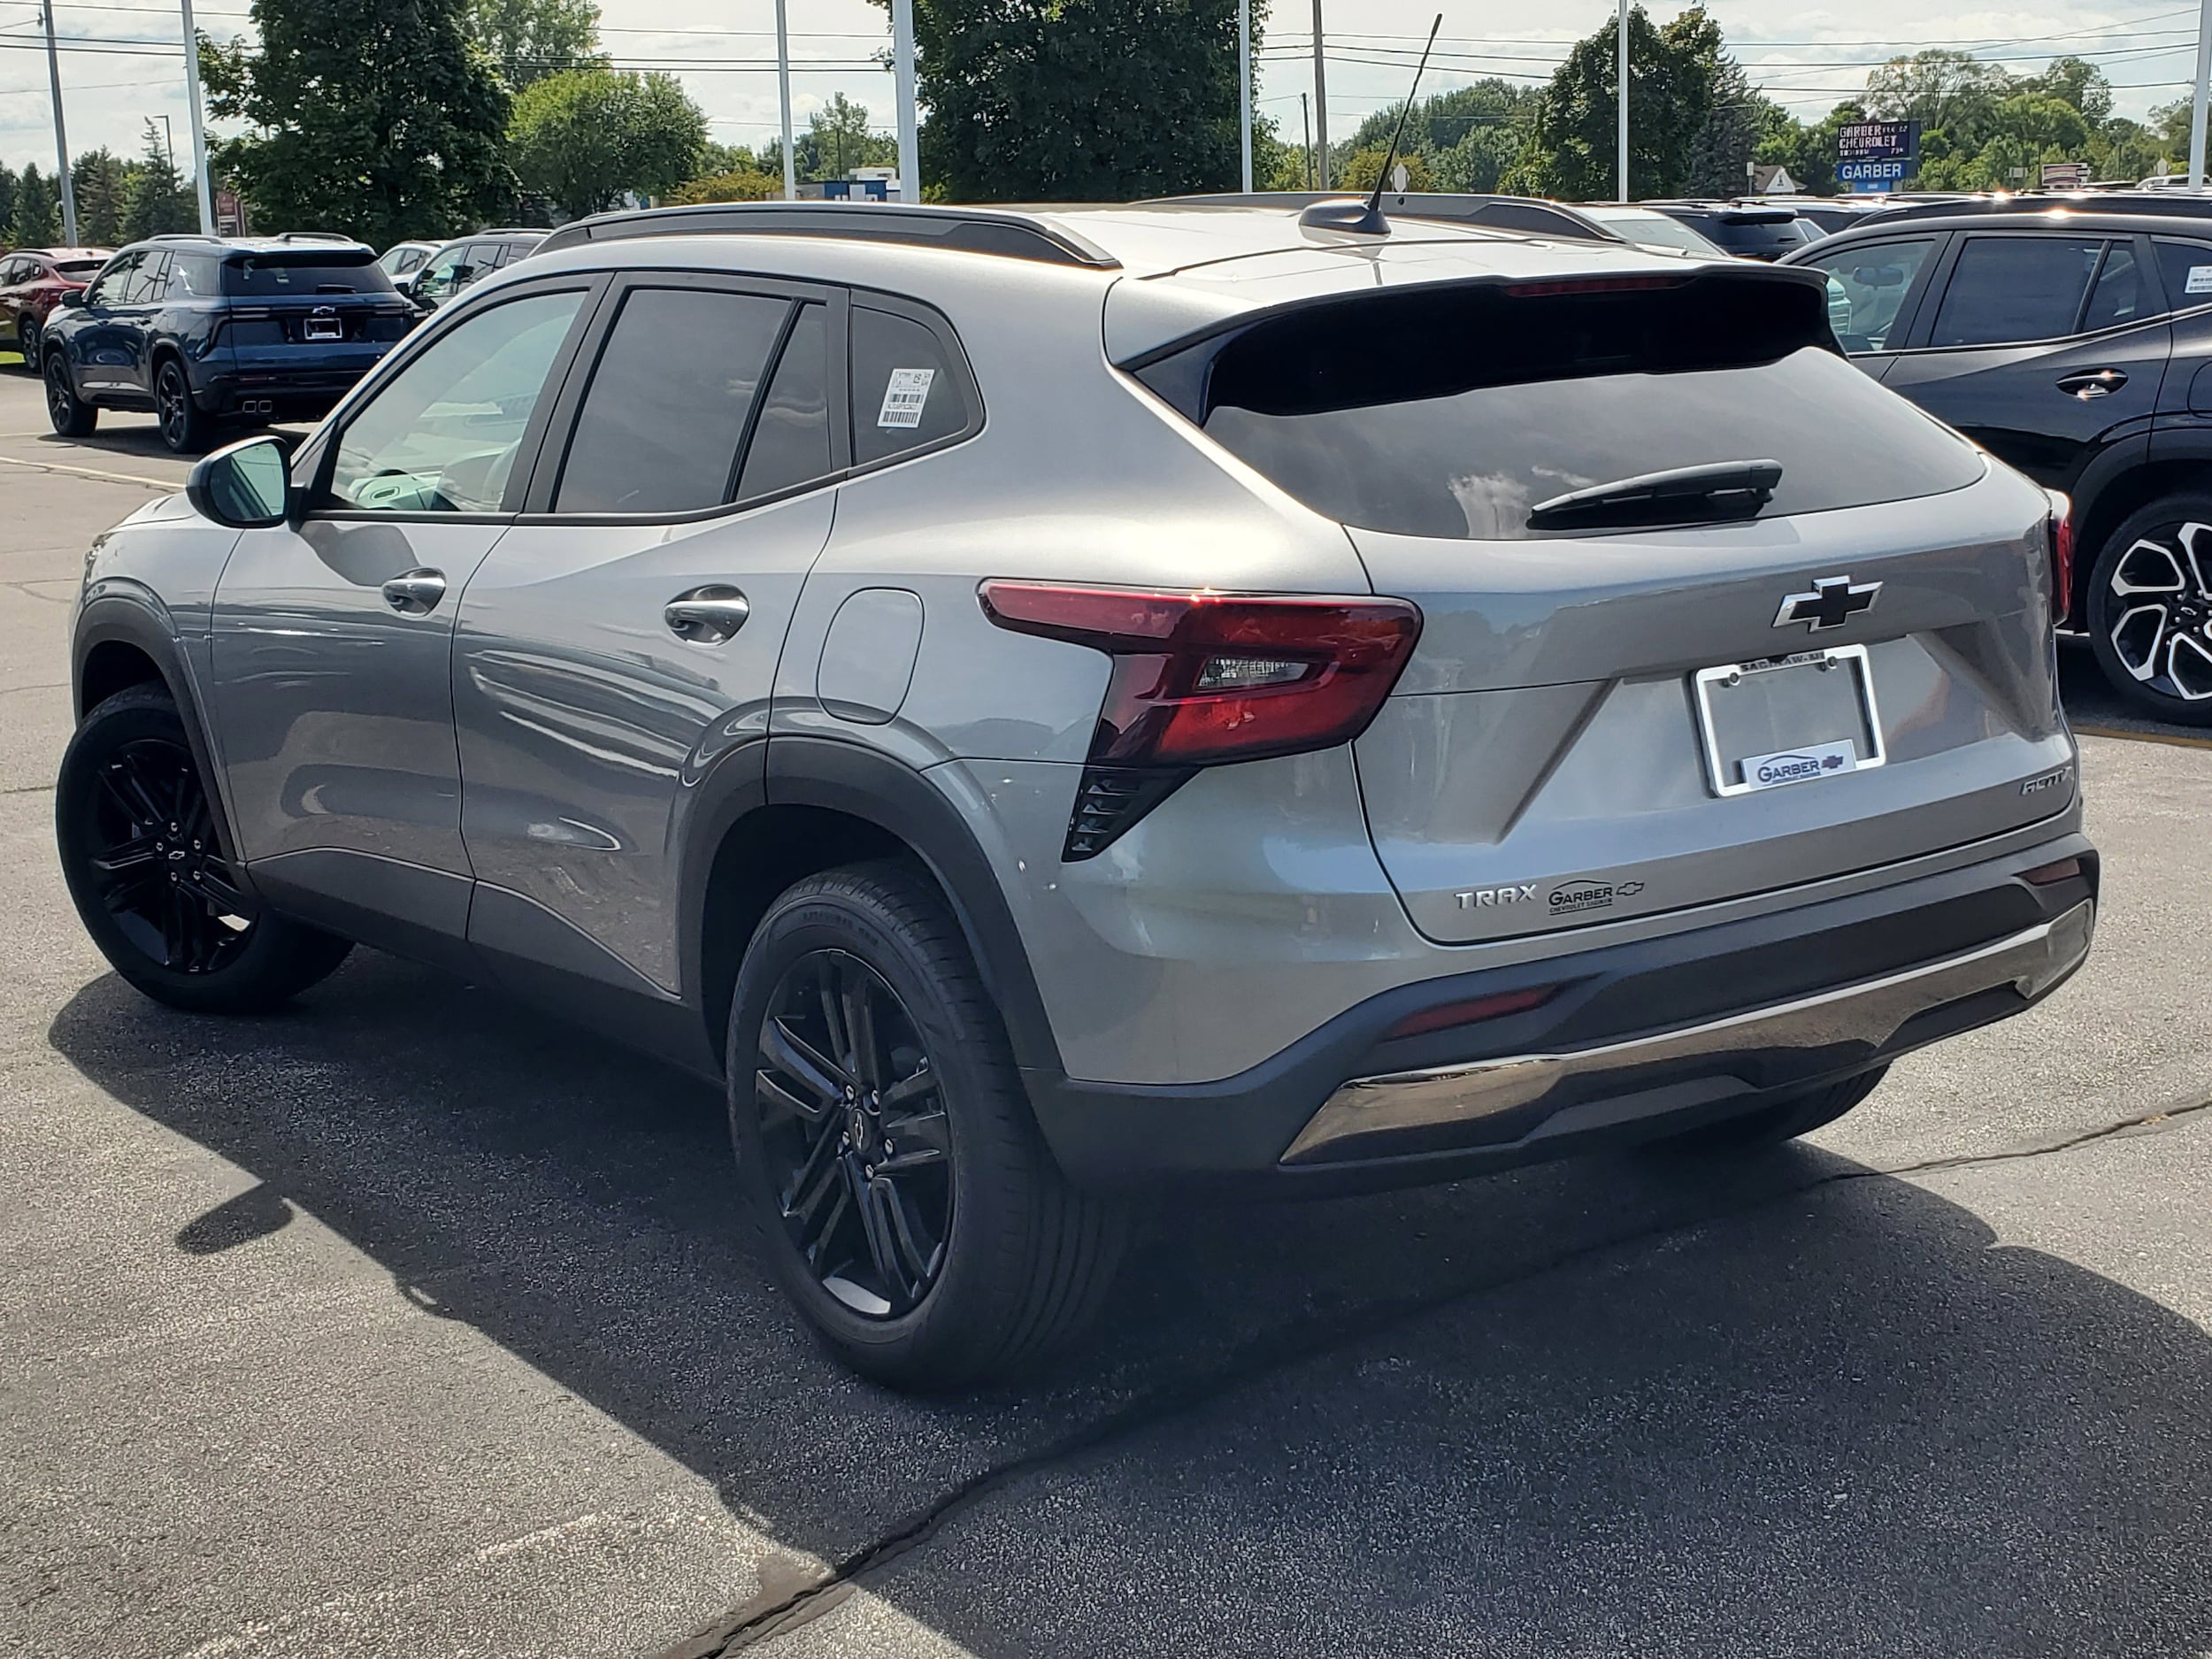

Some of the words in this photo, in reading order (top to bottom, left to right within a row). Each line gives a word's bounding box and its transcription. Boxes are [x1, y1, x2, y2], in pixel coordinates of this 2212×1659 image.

[1839, 125, 1881, 137] GARBER
[1842, 163, 1901, 180] GARBER
[1757, 760, 1820, 783] GARBER
[1455, 884, 1537, 910] TRAX
[1548, 887, 1613, 906] GARBER
